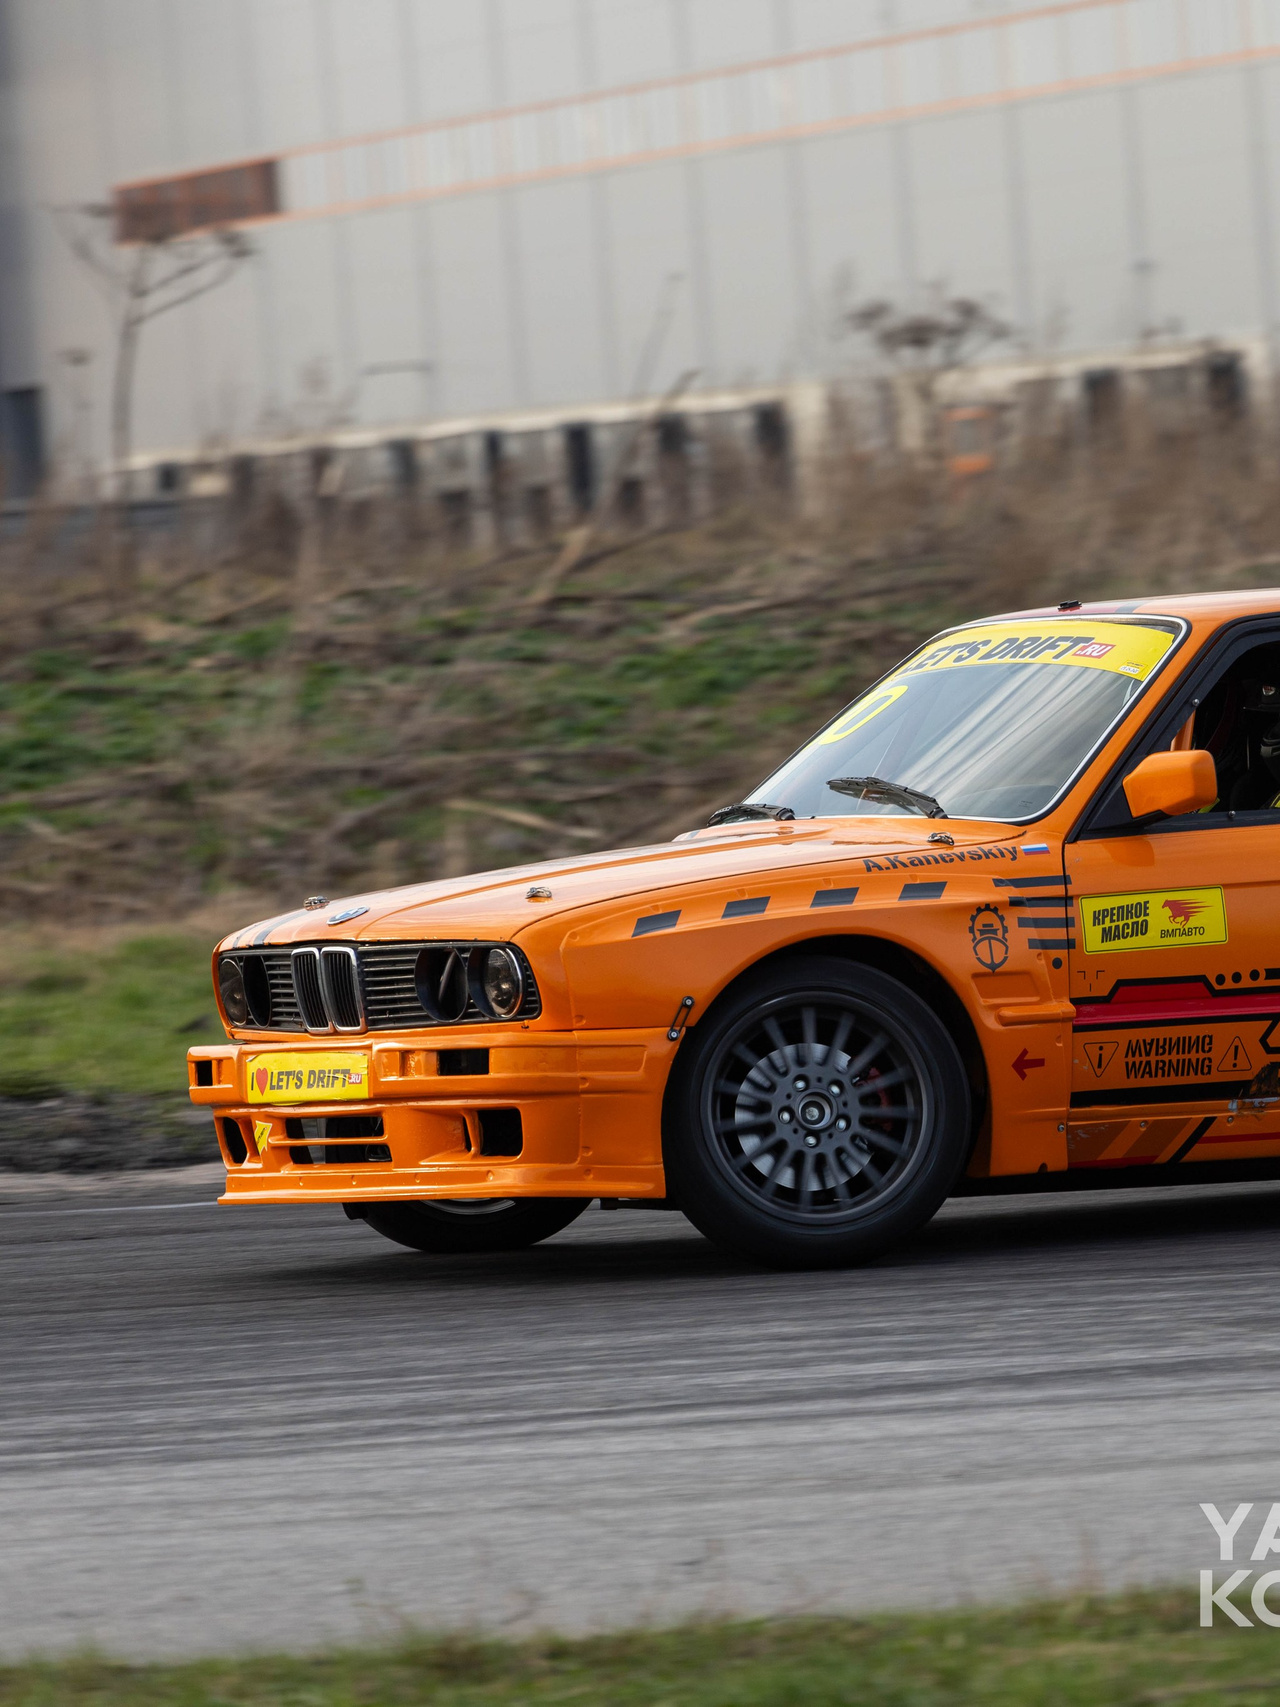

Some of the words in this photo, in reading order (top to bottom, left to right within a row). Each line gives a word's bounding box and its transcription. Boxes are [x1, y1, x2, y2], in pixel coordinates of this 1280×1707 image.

[894, 639, 992, 678] LET'S
[862, 844, 1018, 873] A.Kanevskiy
[1092, 900, 1150, 927] КРЕПКОЕ
[1101, 919, 1149, 943] МАСЛО
[1160, 926, 1205, 939] ВМПАВТО
[1124, 1057, 1213, 1079] WARNING
[269, 1070, 304, 1091] LET'S
